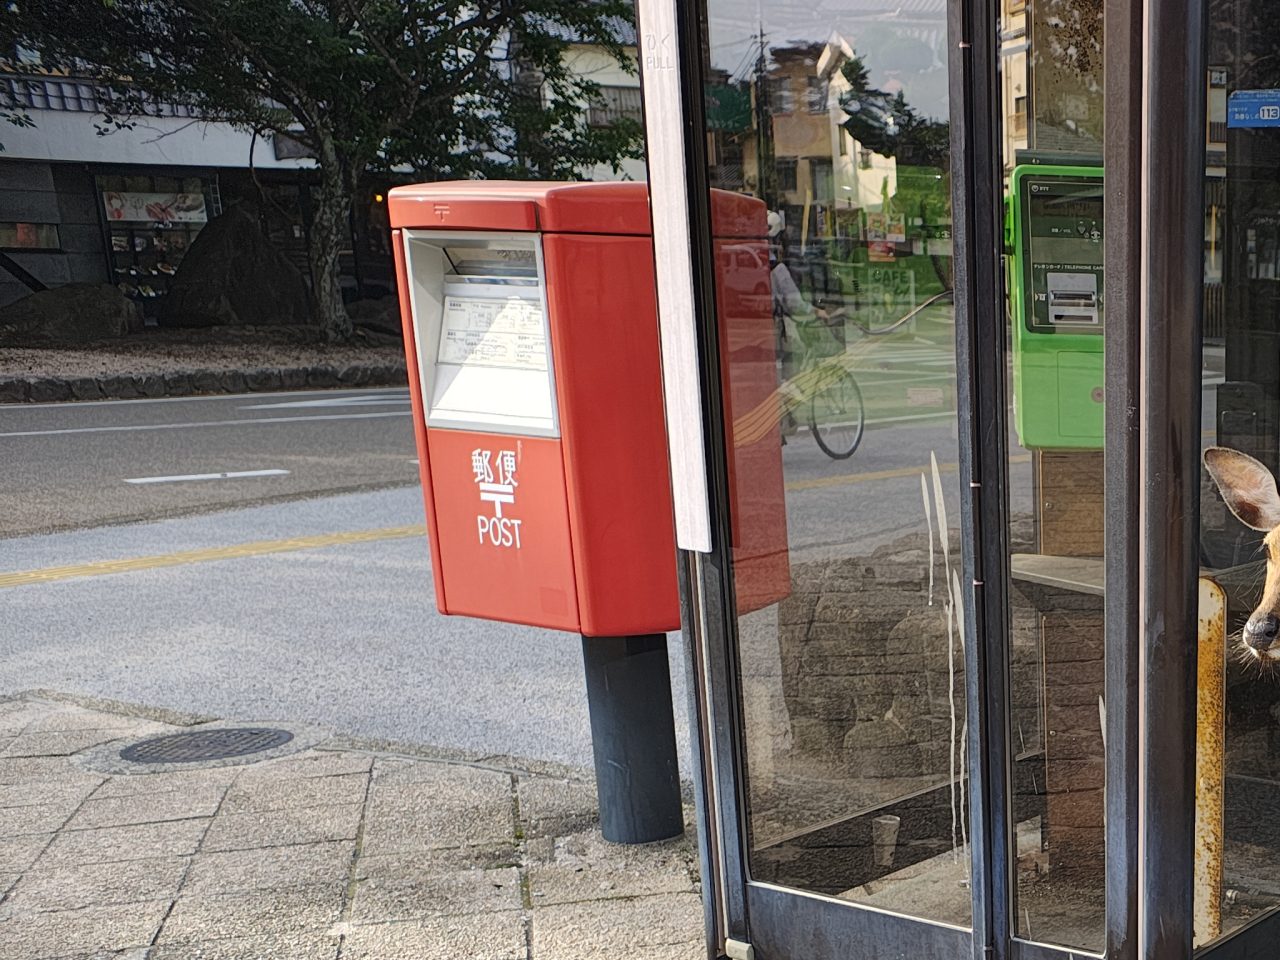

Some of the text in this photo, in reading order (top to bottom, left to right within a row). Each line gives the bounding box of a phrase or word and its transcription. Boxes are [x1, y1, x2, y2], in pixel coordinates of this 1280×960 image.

[645, 33, 670, 50] ひく
[646, 56, 675, 69] PULL
[1260, 108, 1279, 118] 113
[471, 448, 518, 487] 郵便
[477, 515, 521, 549] POST
